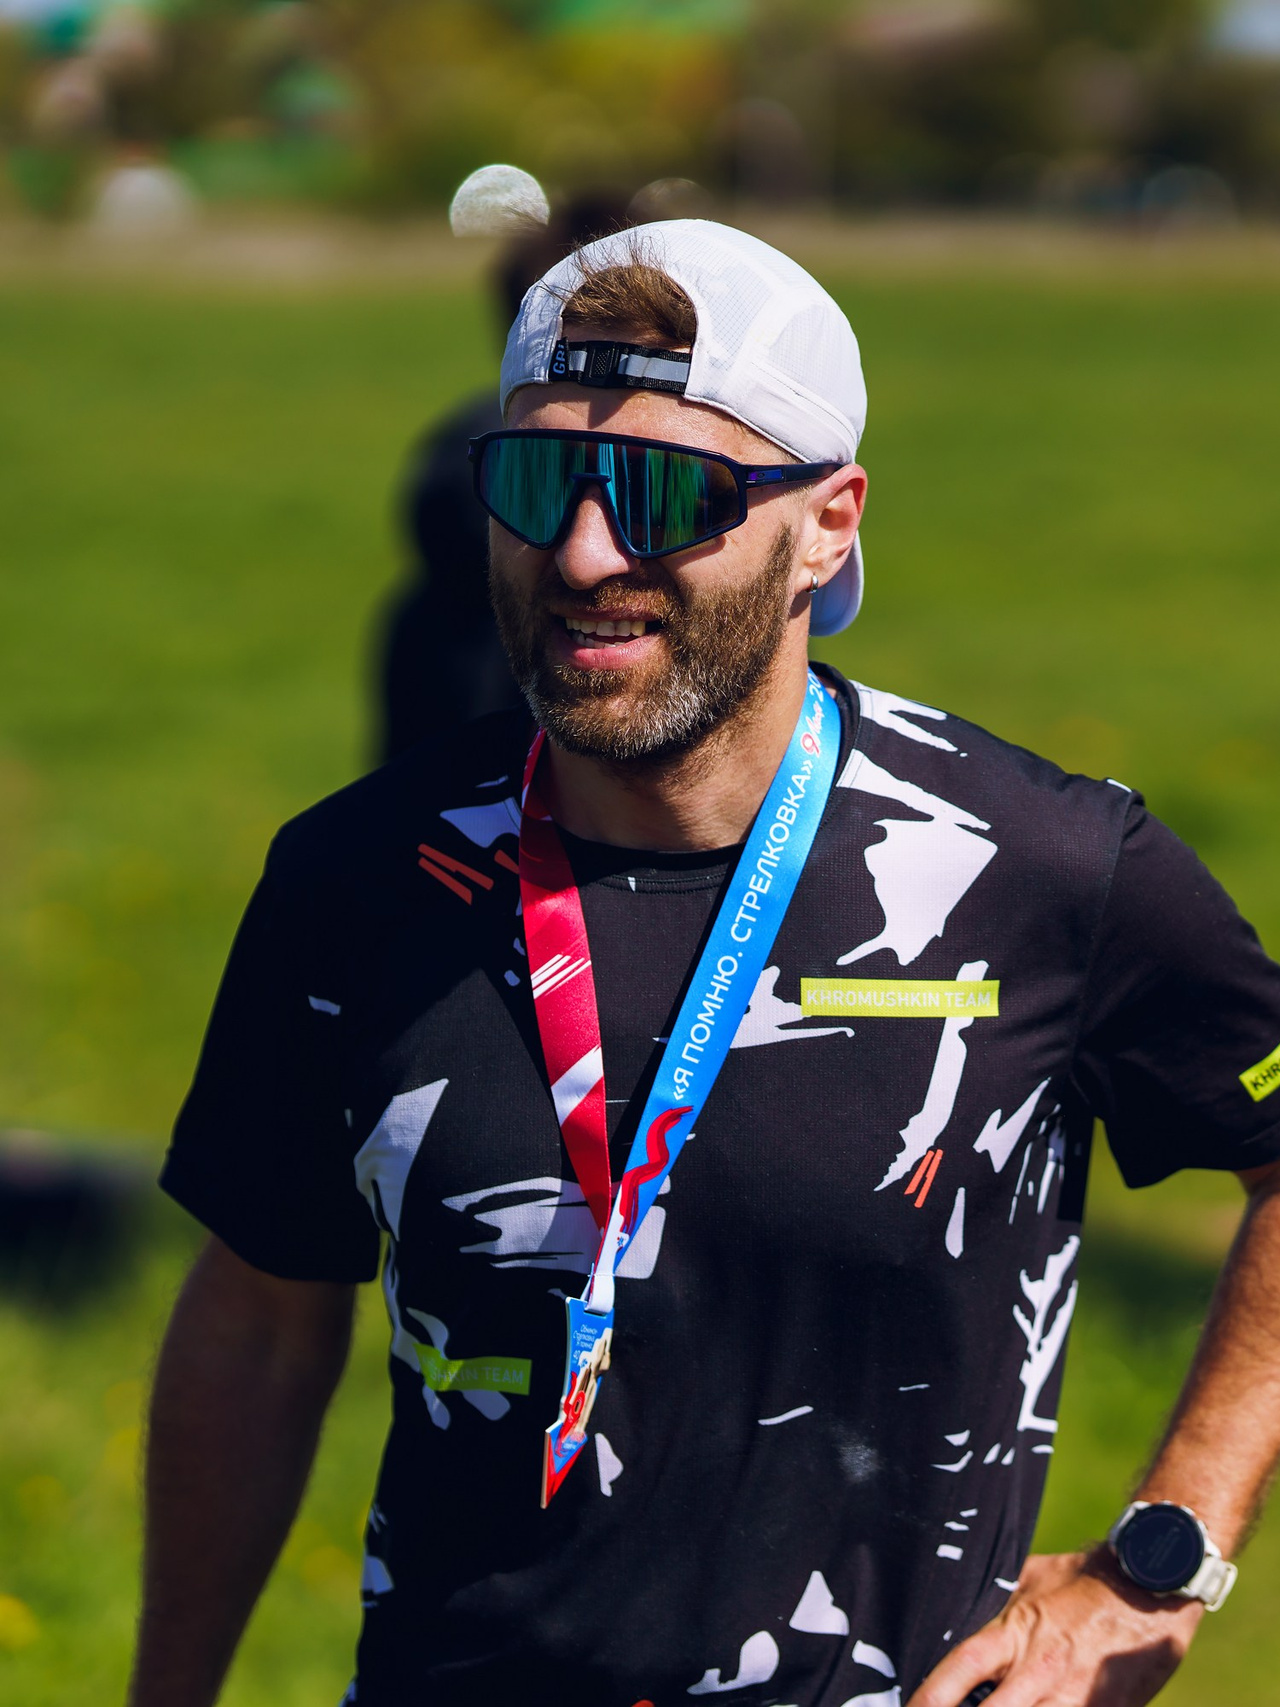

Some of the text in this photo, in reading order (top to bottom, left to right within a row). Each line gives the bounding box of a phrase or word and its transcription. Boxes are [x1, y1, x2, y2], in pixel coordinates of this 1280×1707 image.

[681, 952, 743, 1064] ПОМНЮ.
[730, 759, 814, 943] СТРЕЛКОВКА»
[808, 672, 824, 702] 20
[806, 990, 992, 1008] KHROMUSHKIN TEAM
[483, 1366, 524, 1385] TEAM
